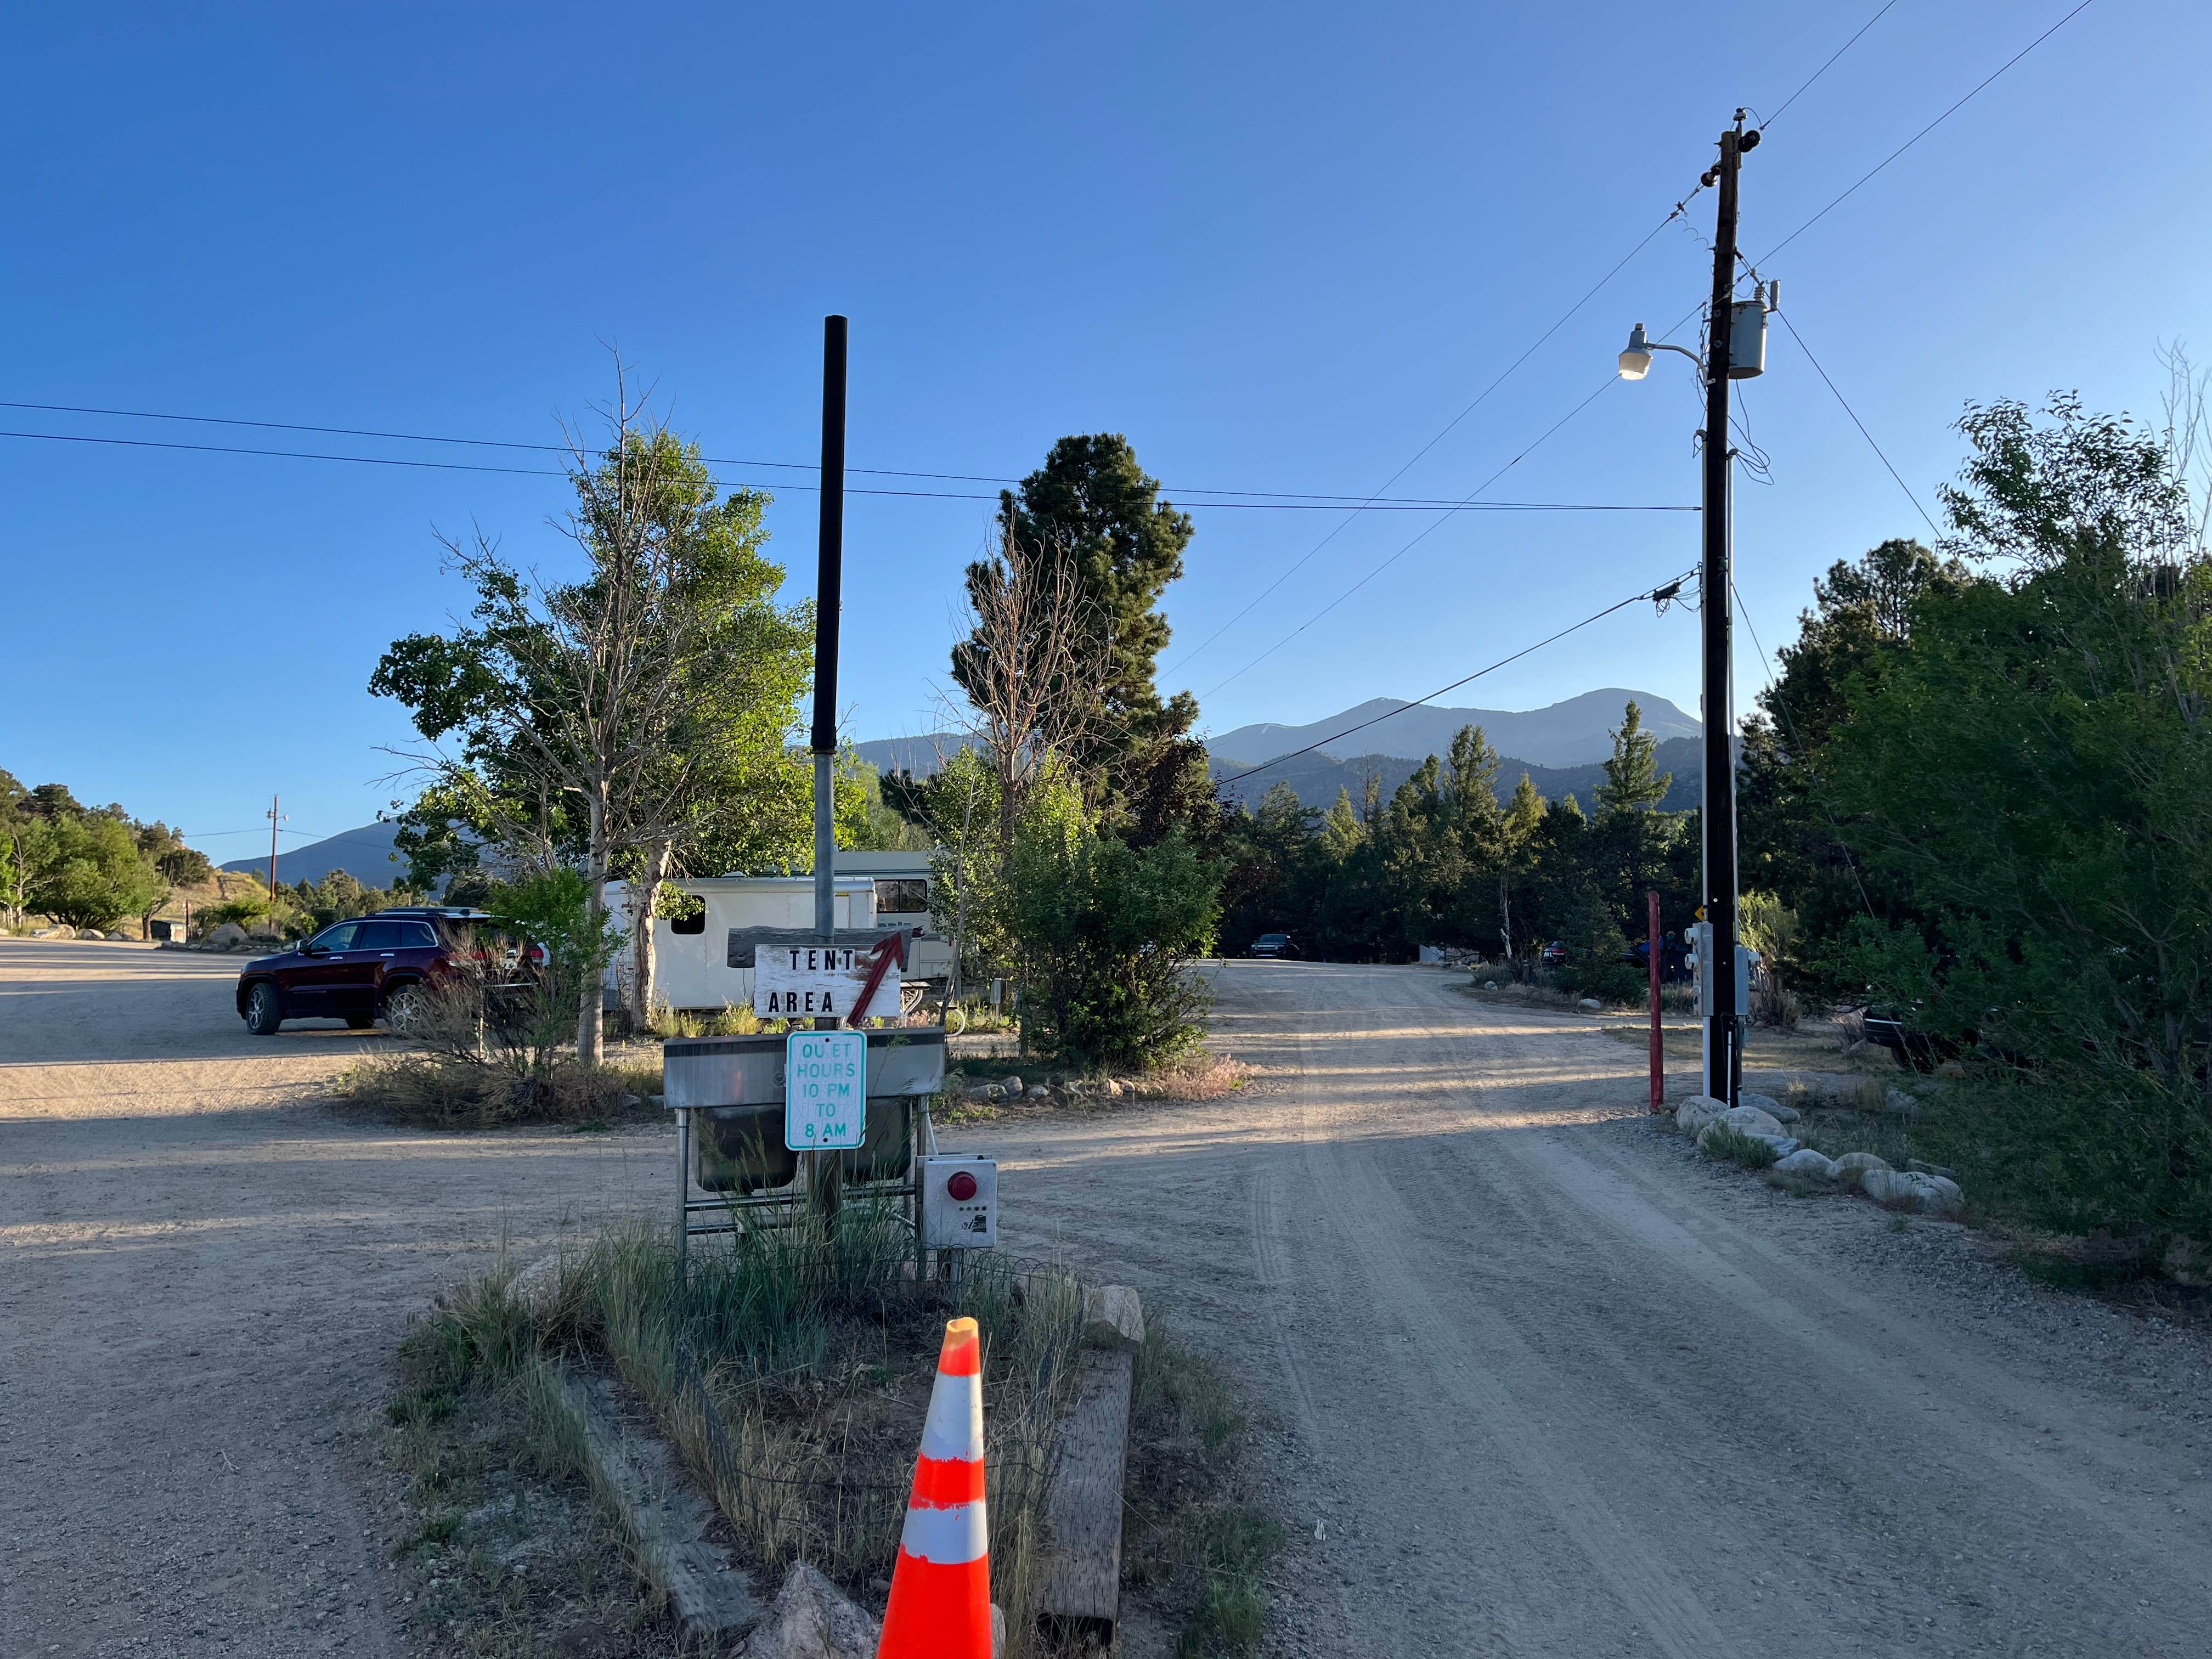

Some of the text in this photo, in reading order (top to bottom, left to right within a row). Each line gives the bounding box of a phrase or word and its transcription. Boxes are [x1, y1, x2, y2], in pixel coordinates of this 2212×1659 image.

[789, 950, 853, 970] TENT
[768, 992, 833, 1012] AREA
[803, 1043, 851, 1058] QUET
[797, 1063, 855, 1078] HOURS
[803, 1084, 850, 1098] 10 PM
[816, 1103, 836, 1118] TO
[805, 1123, 847, 1138] 8 AM
